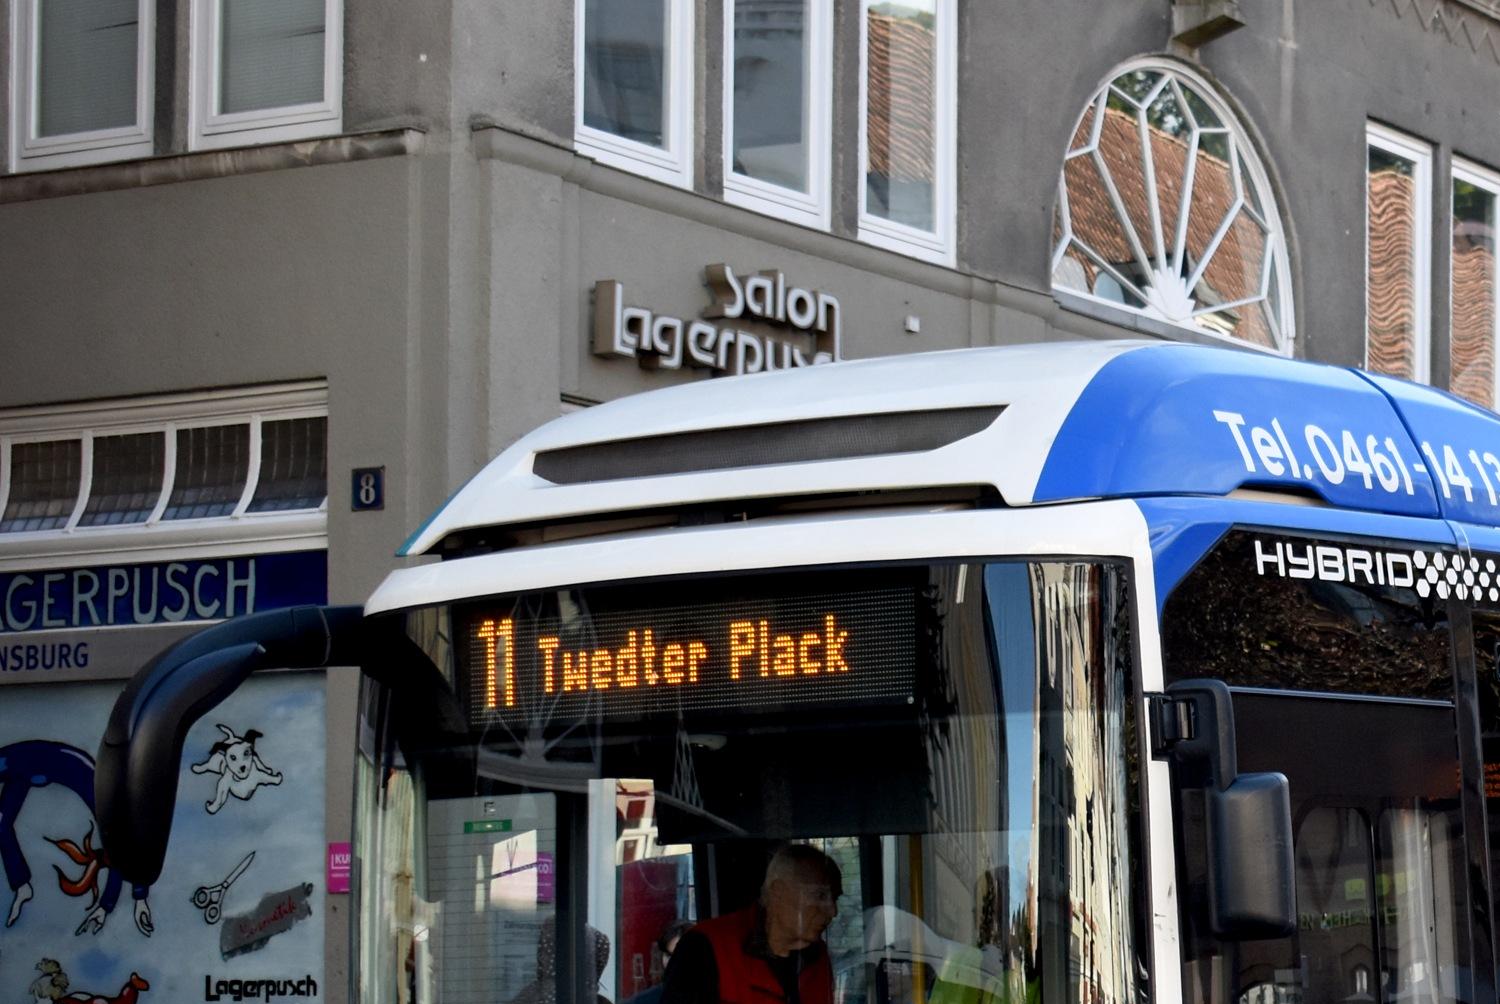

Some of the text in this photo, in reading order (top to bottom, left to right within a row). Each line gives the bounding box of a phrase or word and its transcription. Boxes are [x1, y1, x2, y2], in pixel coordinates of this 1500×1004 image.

[718, 265, 840, 337] Salon
[359, 472, 376, 504] 8
[1255, 540, 1414, 587] HYBRID
[478, 614, 849, 708] 11 Twedter Plack
[205, 975, 318, 1003] Lagerpusch
